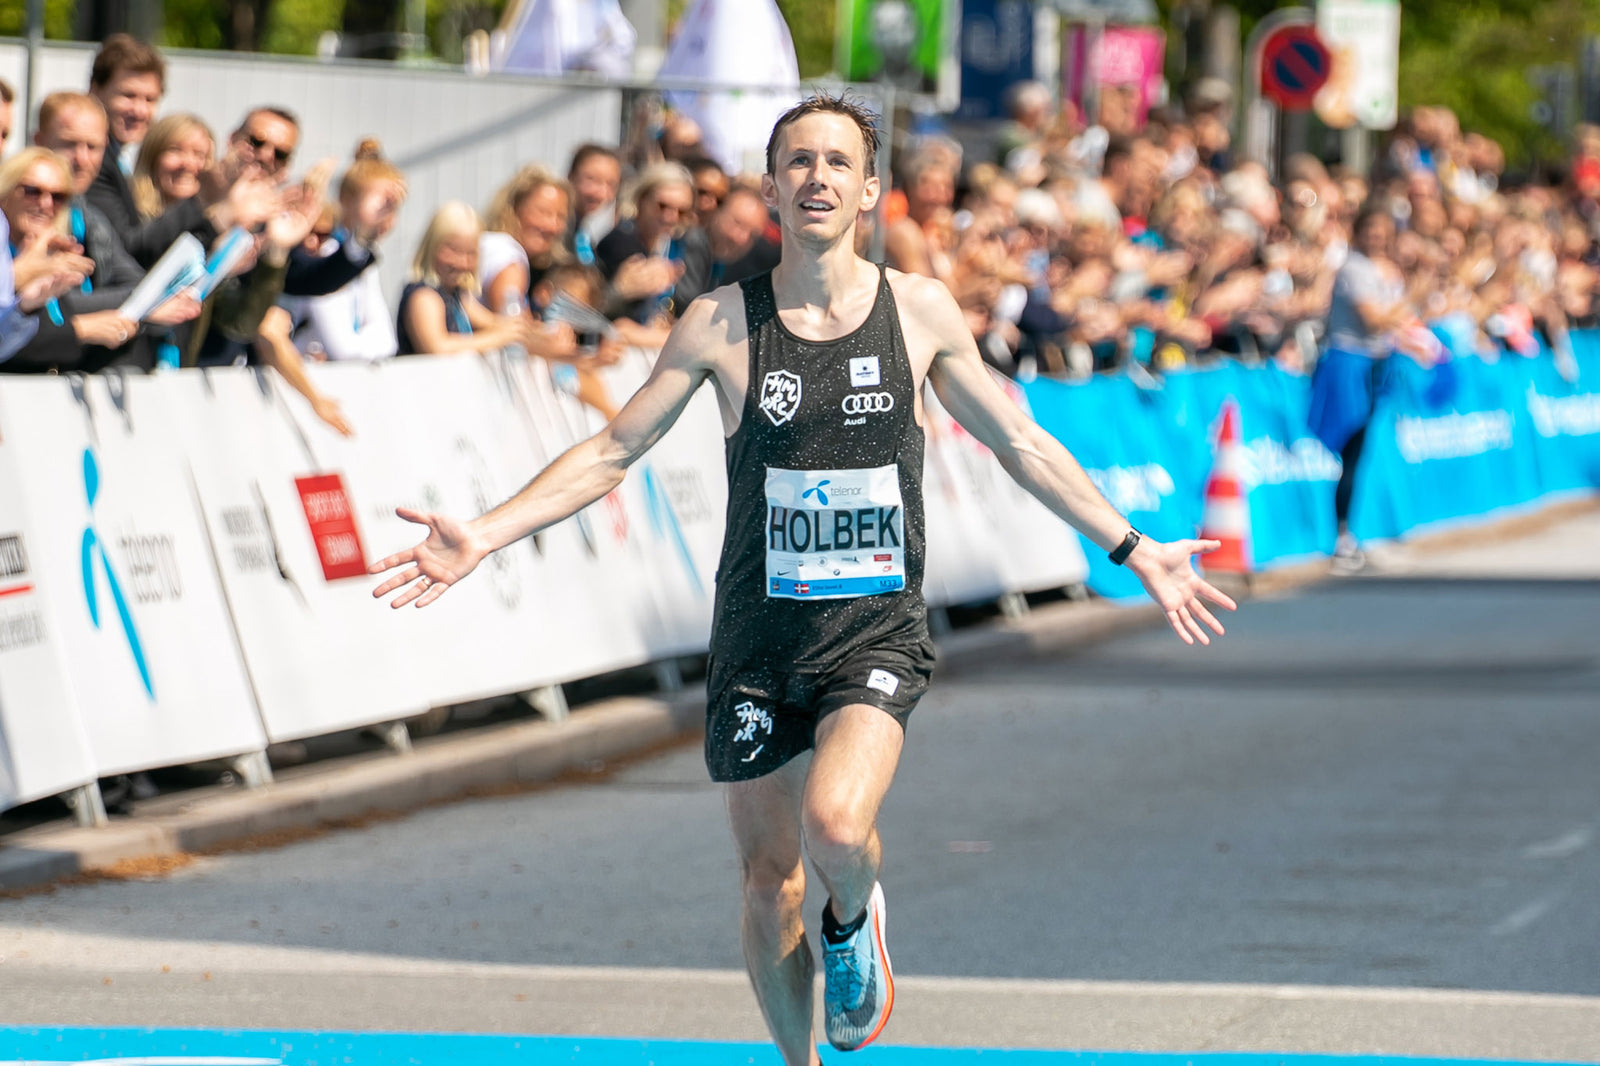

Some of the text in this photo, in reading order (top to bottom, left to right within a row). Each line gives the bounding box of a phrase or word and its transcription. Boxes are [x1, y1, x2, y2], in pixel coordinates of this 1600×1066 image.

[844, 417, 866, 426] Audi
[831, 486, 862, 496] telenor
[770, 506, 900, 553] HOLBEK
